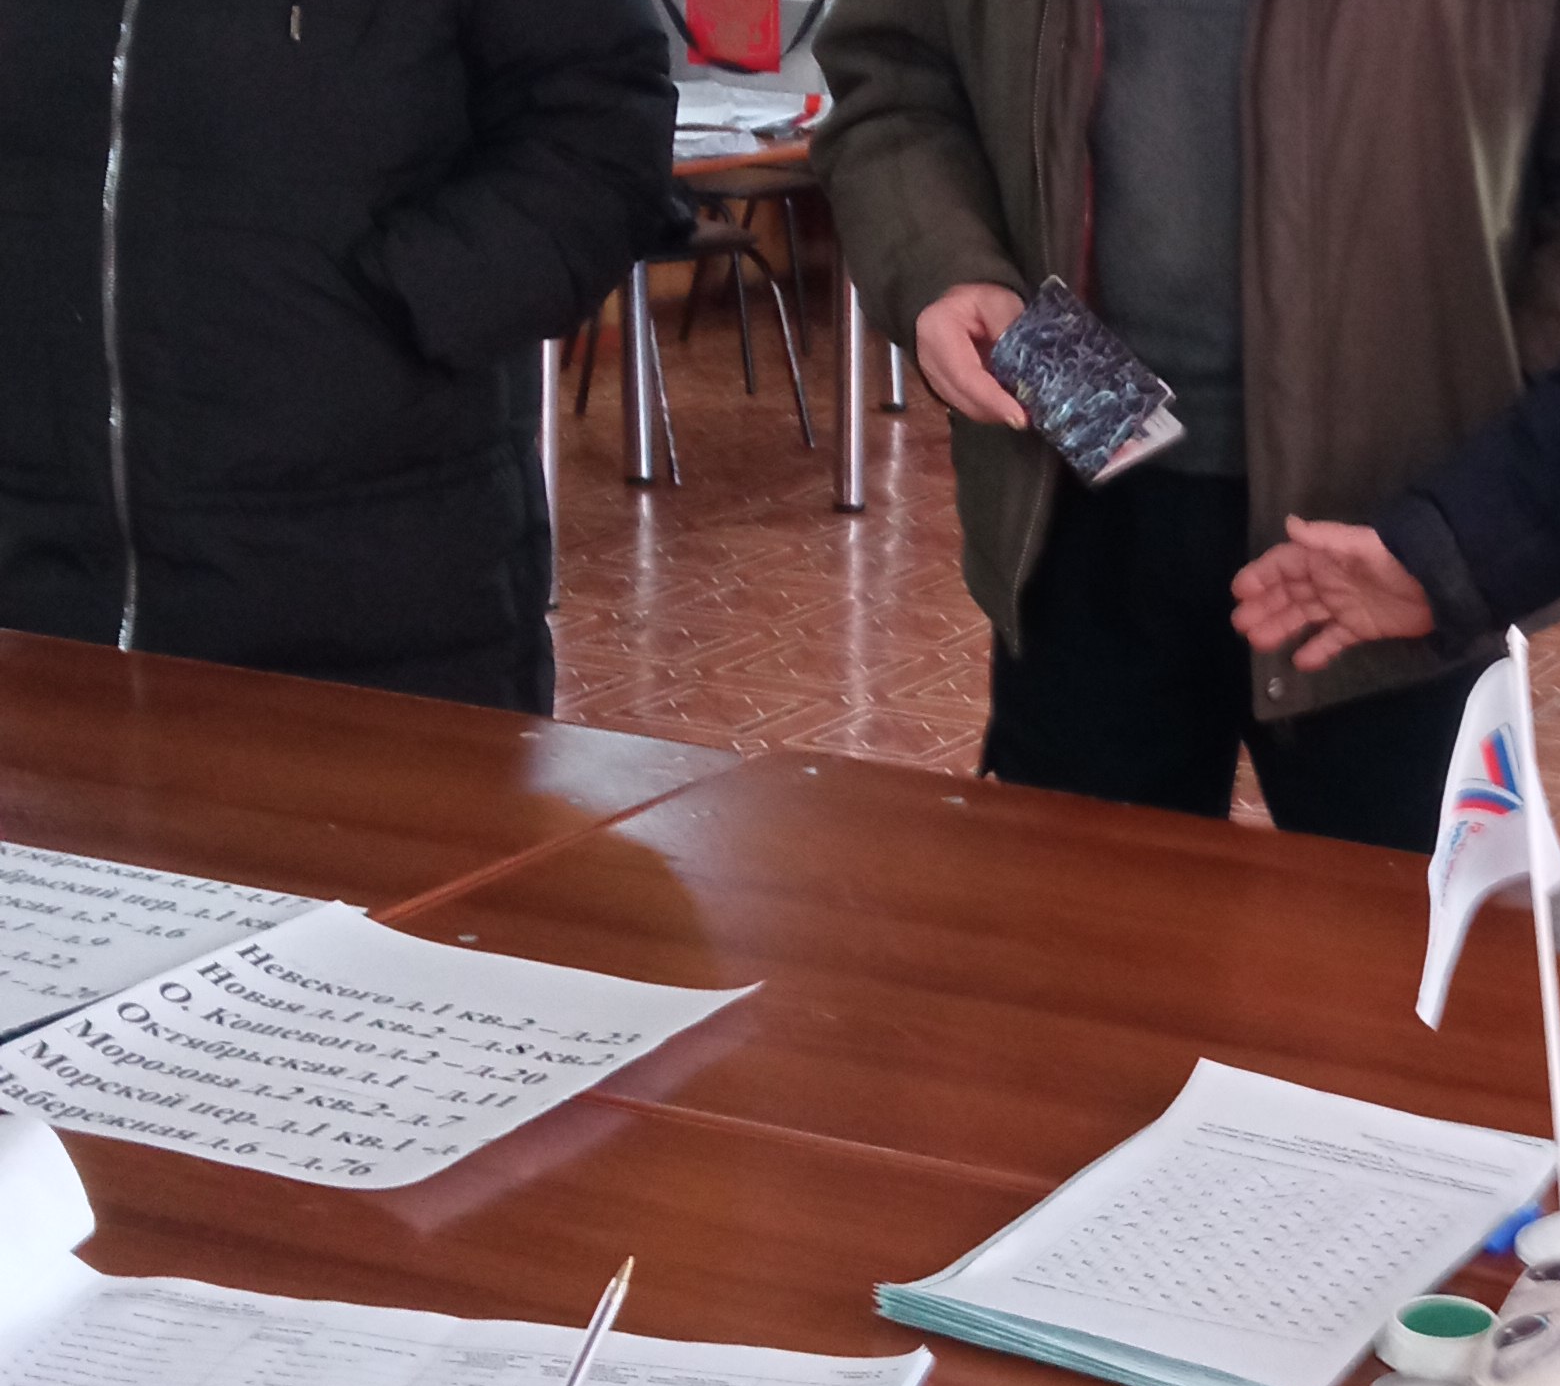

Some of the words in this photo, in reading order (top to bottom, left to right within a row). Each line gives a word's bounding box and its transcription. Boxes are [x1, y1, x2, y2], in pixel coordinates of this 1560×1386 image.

[158, 980, 194, 1012] О.
[200, 1006, 378, 1054] Кошевого
[376, 1047, 441, 1065] д.2
[465, 1064, 550, 1085] д.20
[196, 961, 306, 1014] Новая
[304, 1008, 365, 1024] д.1
[366, 1017, 447, 1040] кв.2
[533, 1050, 616, 1067] кв.2
[236, 943, 396, 1006] Невского
[395, 1000, 454, 1016] д.1
[456, 1010, 537, 1031] кв.2
[19, 1039, 190, 1109] Морской
[187, 1099, 261, 1127] пер.
[264, 1118, 331, 1137] д.1
[331, 1130, 417, 1153] кв.1
[65, 1017, 241, 1089] Морозова
[240, 1083, 305, 1102] д.2
[395, 1113, 468, 1129] д.7
[116, 1000, 348, 1078] Октябрьская
[347, 1070, 409, 1089] д.1
[436, 1088, 519, 1108] д.11
[198, 1136, 262, 1156] д.6
[288, 1156, 378, 1177] д.76
